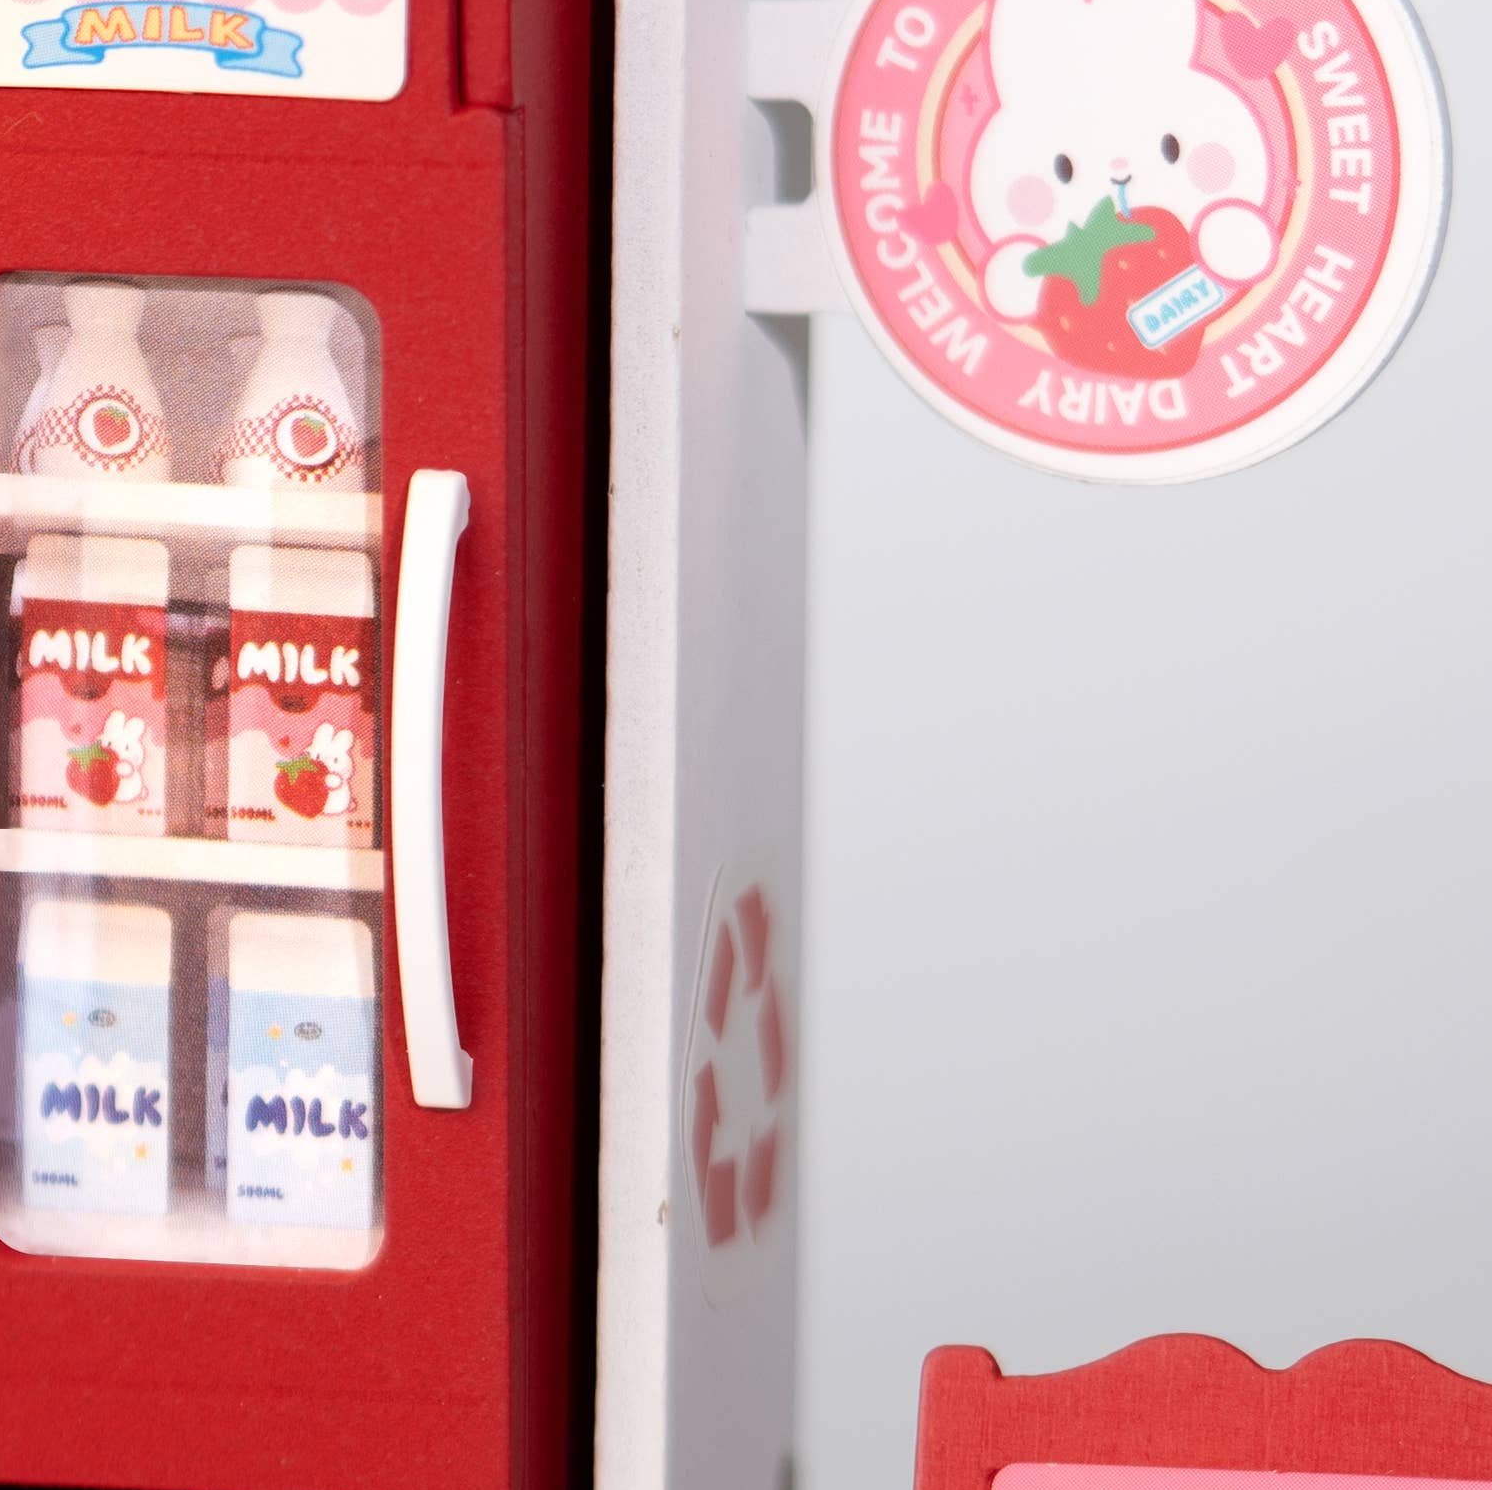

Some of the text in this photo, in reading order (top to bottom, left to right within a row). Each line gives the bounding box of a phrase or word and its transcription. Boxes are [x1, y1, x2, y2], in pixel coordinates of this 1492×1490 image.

[75, 5, 254, 50] MILK
[876, 4, 936, 73] TO
[1298, 20, 1372, 214] SWEET
[858, 108, 989, 376] WELCOME
[1144, 278, 1209, 333] DAIRY
[1223, 243, 1355, 400] HEART
[1017, 377, 1188, 426] DAIRY
[29, 628, 152, 675] MILK
[237, 641, 361, 687] MILK
[40, 1081, 163, 1127] MILK
[245, 1094, 369, 1140] MILK
